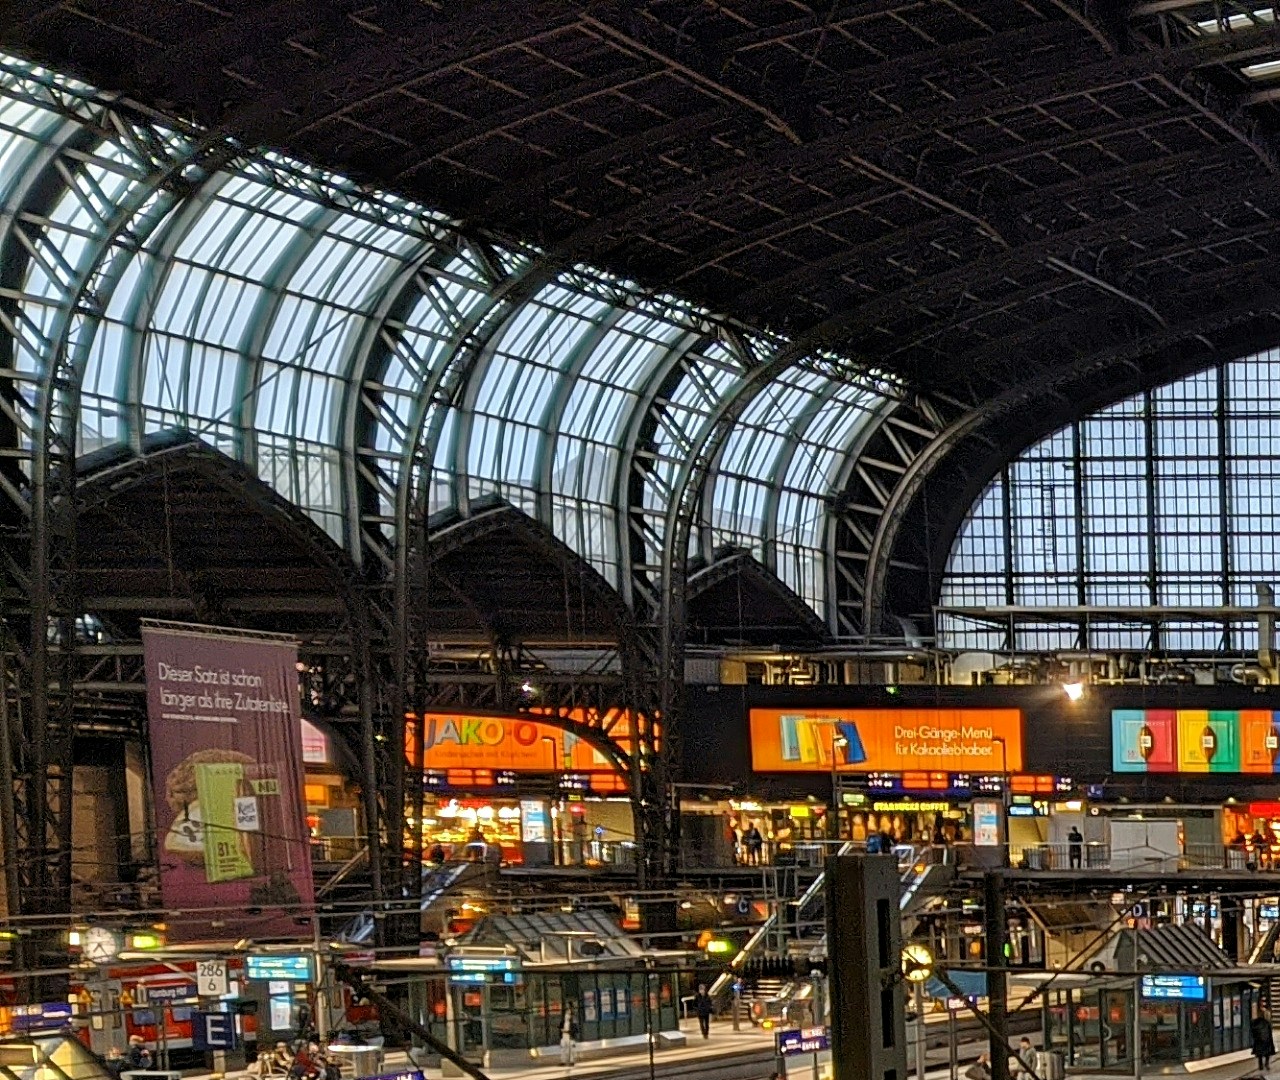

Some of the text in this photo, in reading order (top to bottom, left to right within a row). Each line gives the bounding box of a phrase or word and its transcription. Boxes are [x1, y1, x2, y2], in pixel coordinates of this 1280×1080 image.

[159, 662, 262, 687] Dieser Satz ist schon
[160, 686, 196, 712] länger
[198, 689, 212, 709] als
[422, 718, 538, 751] JAKO-O
[894, 725, 993, 743] Drei-Gänge-Menü
[895, 742, 909, 756] für
[200, 964, 224, 977] 286
[207, 978, 217, 992] 6
[205, 1014, 227, 1046] E
